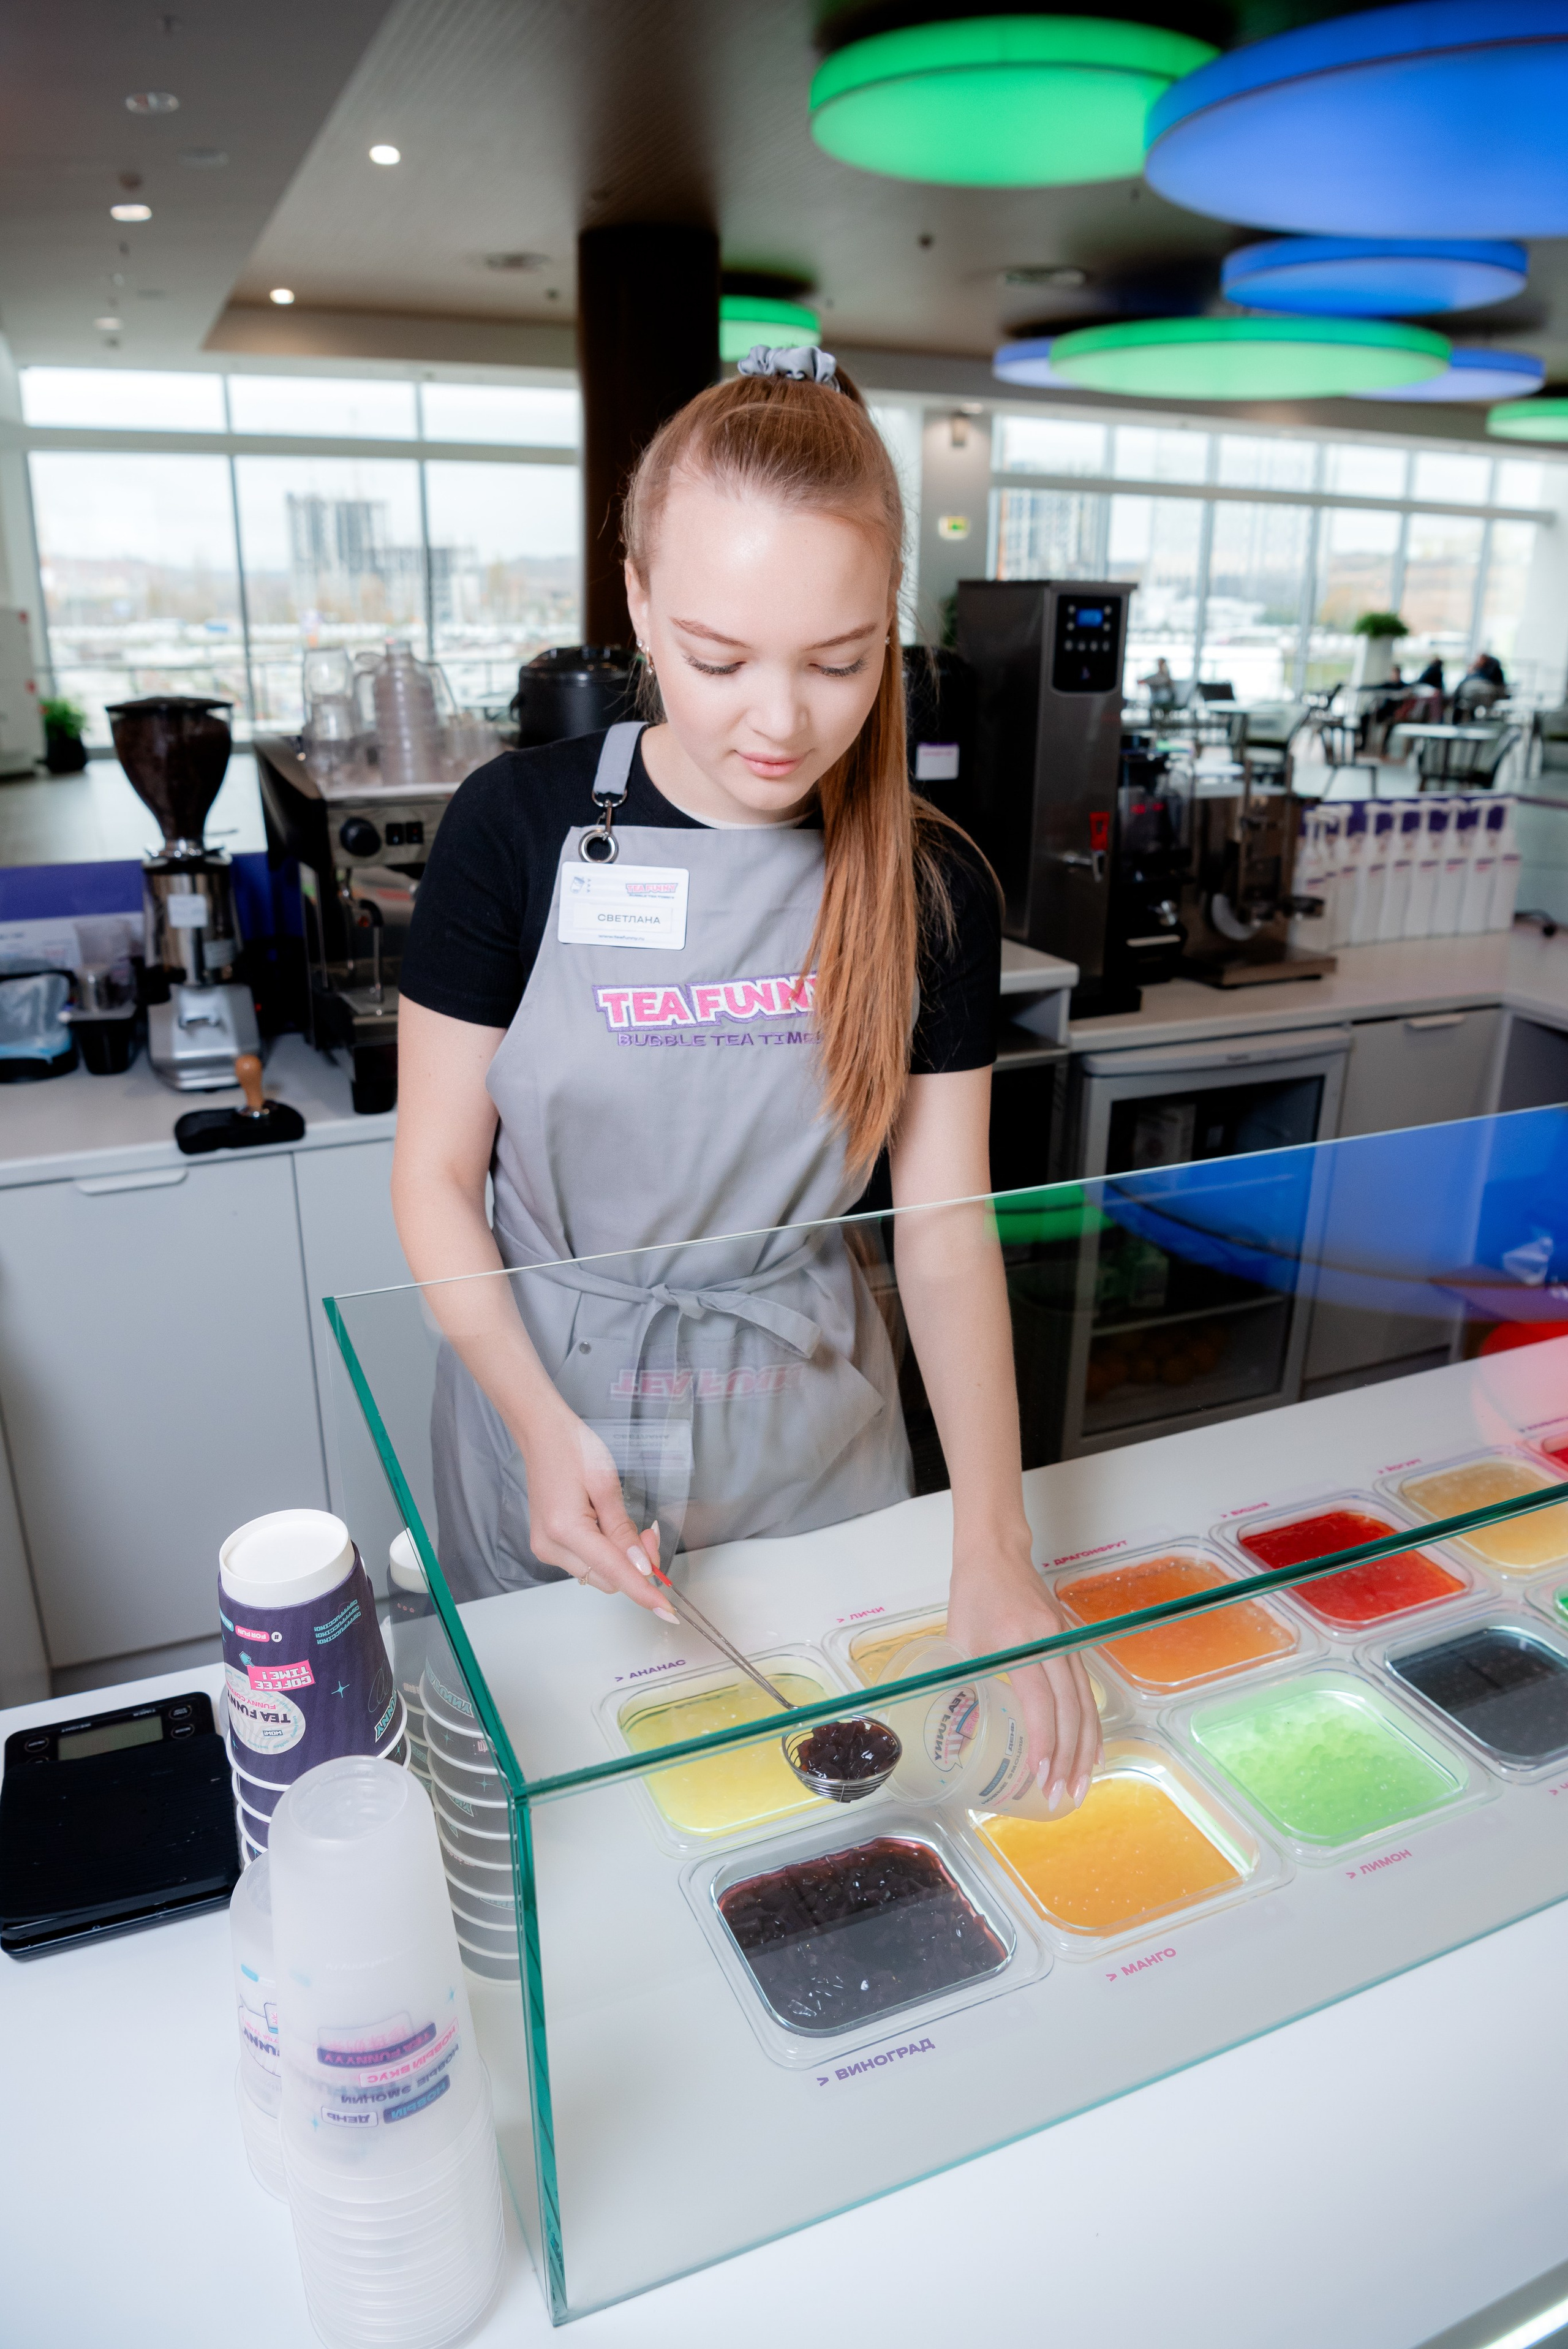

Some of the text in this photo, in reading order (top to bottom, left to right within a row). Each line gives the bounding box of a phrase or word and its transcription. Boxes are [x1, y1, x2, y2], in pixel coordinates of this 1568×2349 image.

[597, 913, 661, 924] СВЕТЛАНА
[602, 991, 690, 1023] TEA
[617, 1032, 706, 1047] BUBBLE
[710, 1033, 755, 1046] TEA
[850, 1606, 885, 1620] ЛИЧИ
[237, 1628, 251, 1637] FUN
[630, 1659, 686, 1678] АНАНАС
[254, 1675, 312, 1689] COFFEE
[247, 1700, 276, 1710] FUNNY
[259, 1711, 291, 1724] TEA
[1359, 1849, 1412, 1874] ЛИМОН
[1120, 1948, 1177, 1976] МАНГО
[834, 2038, 936, 2081] ВИНОГРАД
[341, 2043, 459, 2105] НОВЫЕ ЭМОЦИИ
[368, 2064, 410, 2083] ВКУС
[326, 2112, 370, 2124] ДЕНЬ
